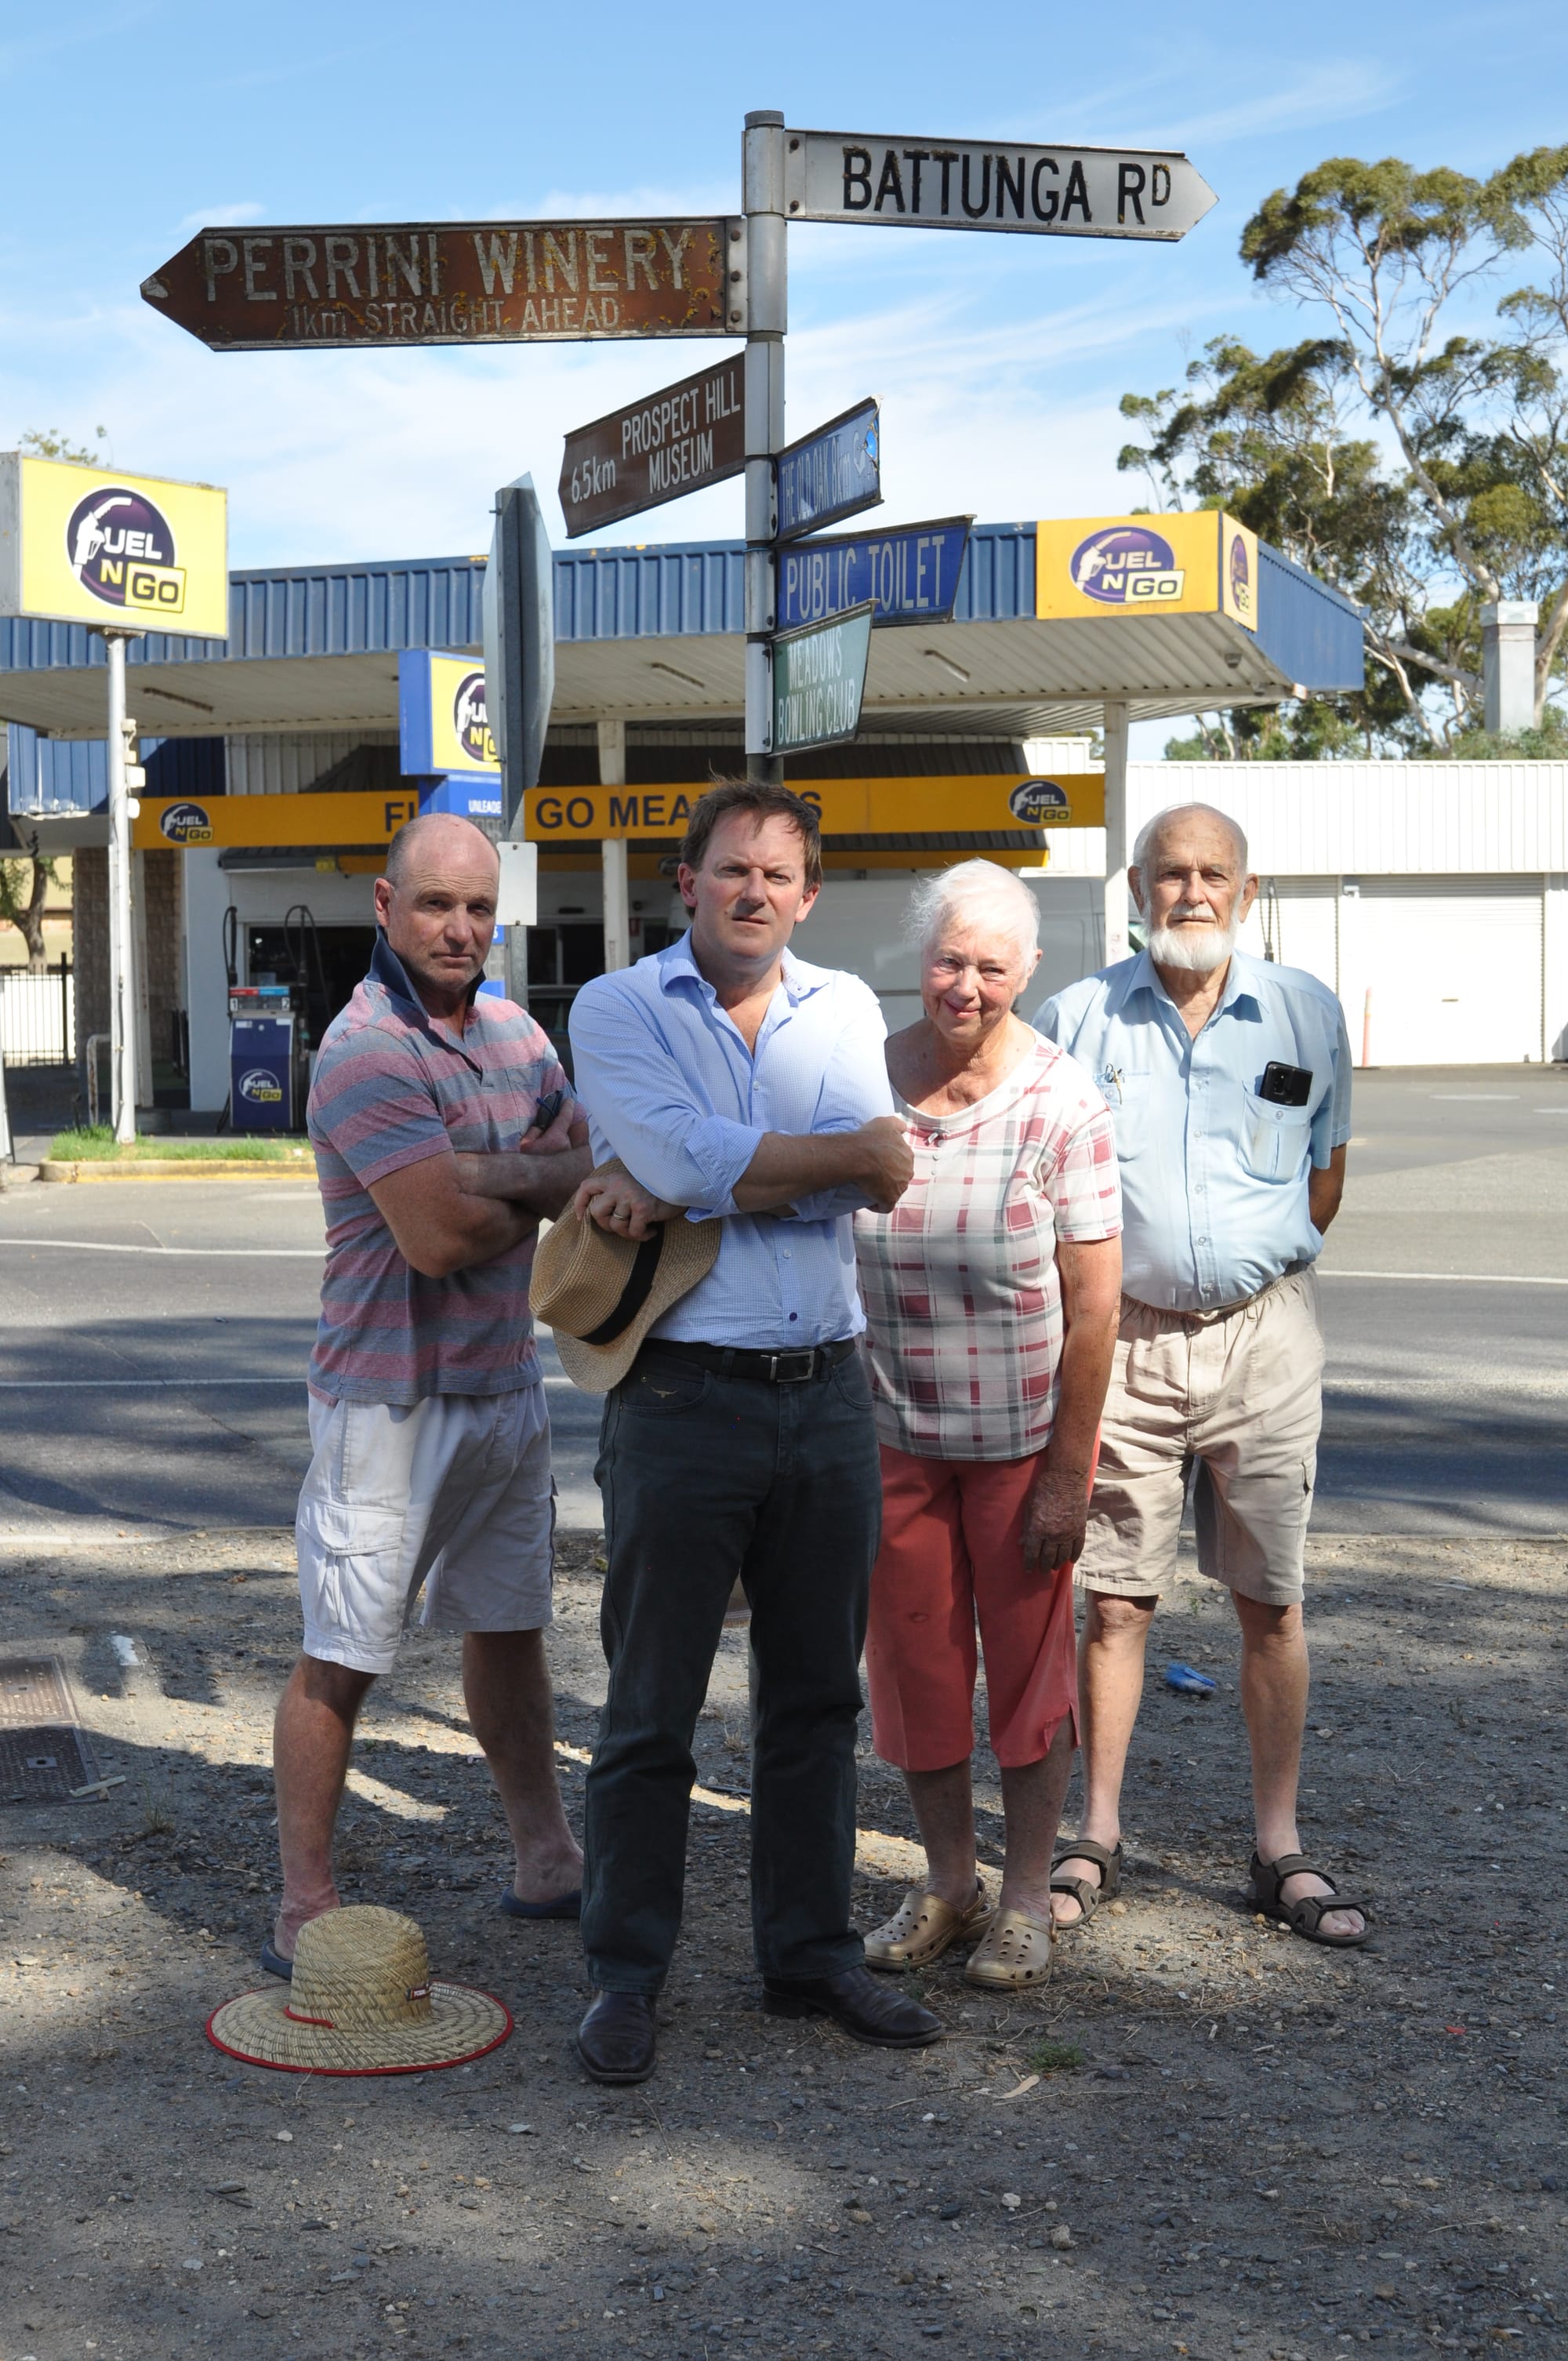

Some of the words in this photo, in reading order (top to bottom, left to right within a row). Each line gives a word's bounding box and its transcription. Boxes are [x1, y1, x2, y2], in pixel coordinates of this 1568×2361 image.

[841, 146, 1093, 223] BATTUNGA
[1116, 162, 1171, 225] RD
[204, 233, 441, 302] PERRINI
[474, 227, 692, 294] WINERY
[365, 300, 504, 335] STRAIGHT
[521, 296, 620, 331] AHEAD
[622, 387, 699, 460] PROSPECT
[706, 371, 741, 424] HILL
[571, 455, 616, 504] 6.5km
[648, 429, 713, 494] MUSEUM
[132, 571, 180, 605] GO
[786, 547, 857, 620] PUBLIC
[868, 535, 946, 612] TOILET
[1131, 577, 1178, 596] GO
[787, 624, 843, 691] MEADOWS
[777, 685, 824, 746] BOWLING
[826, 677, 858, 736] CLUB
[189, 829, 211, 840] GO
[535, 797, 595, 830] GO
[1044, 809, 1069, 820] GO
